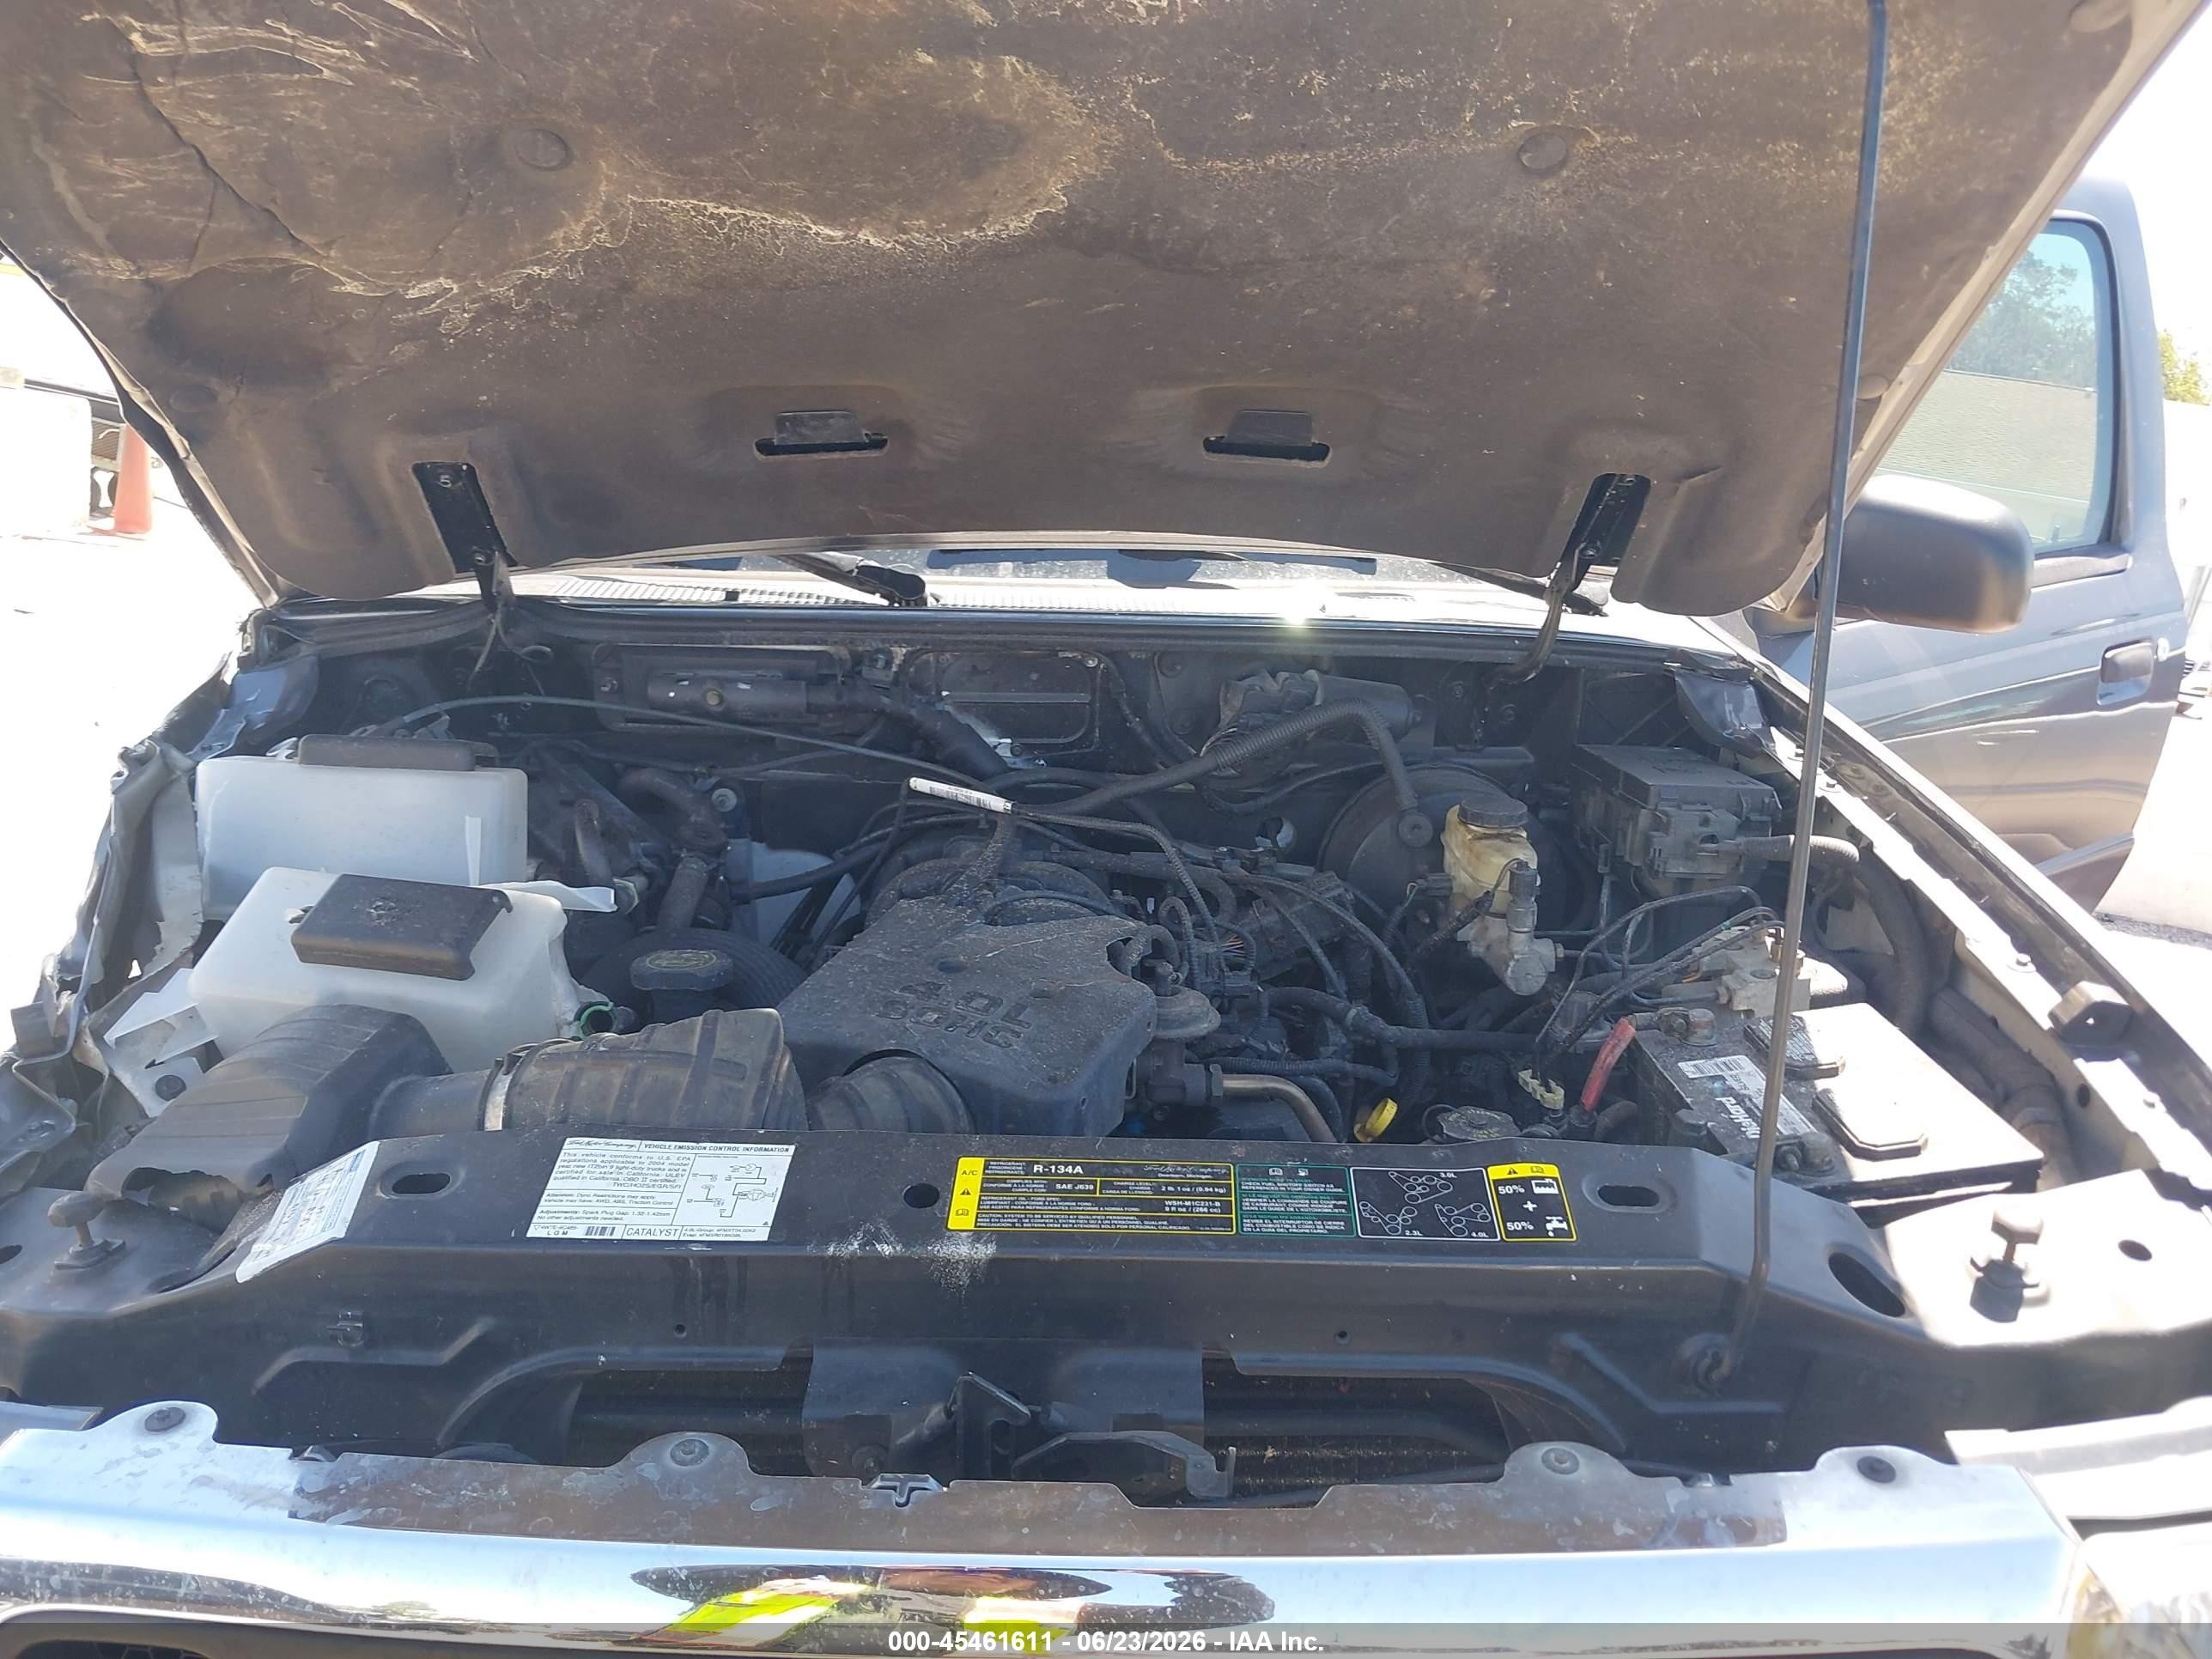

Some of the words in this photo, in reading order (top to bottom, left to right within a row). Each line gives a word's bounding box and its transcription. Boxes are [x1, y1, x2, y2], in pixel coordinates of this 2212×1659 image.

[1034, 1164, 1084, 1175] R-134A
[1498, 1185, 1525, 1194] 50%
[1506, 1221, 1534, 1231] 50%
[627, 1228, 680, 1238] CATALYST
